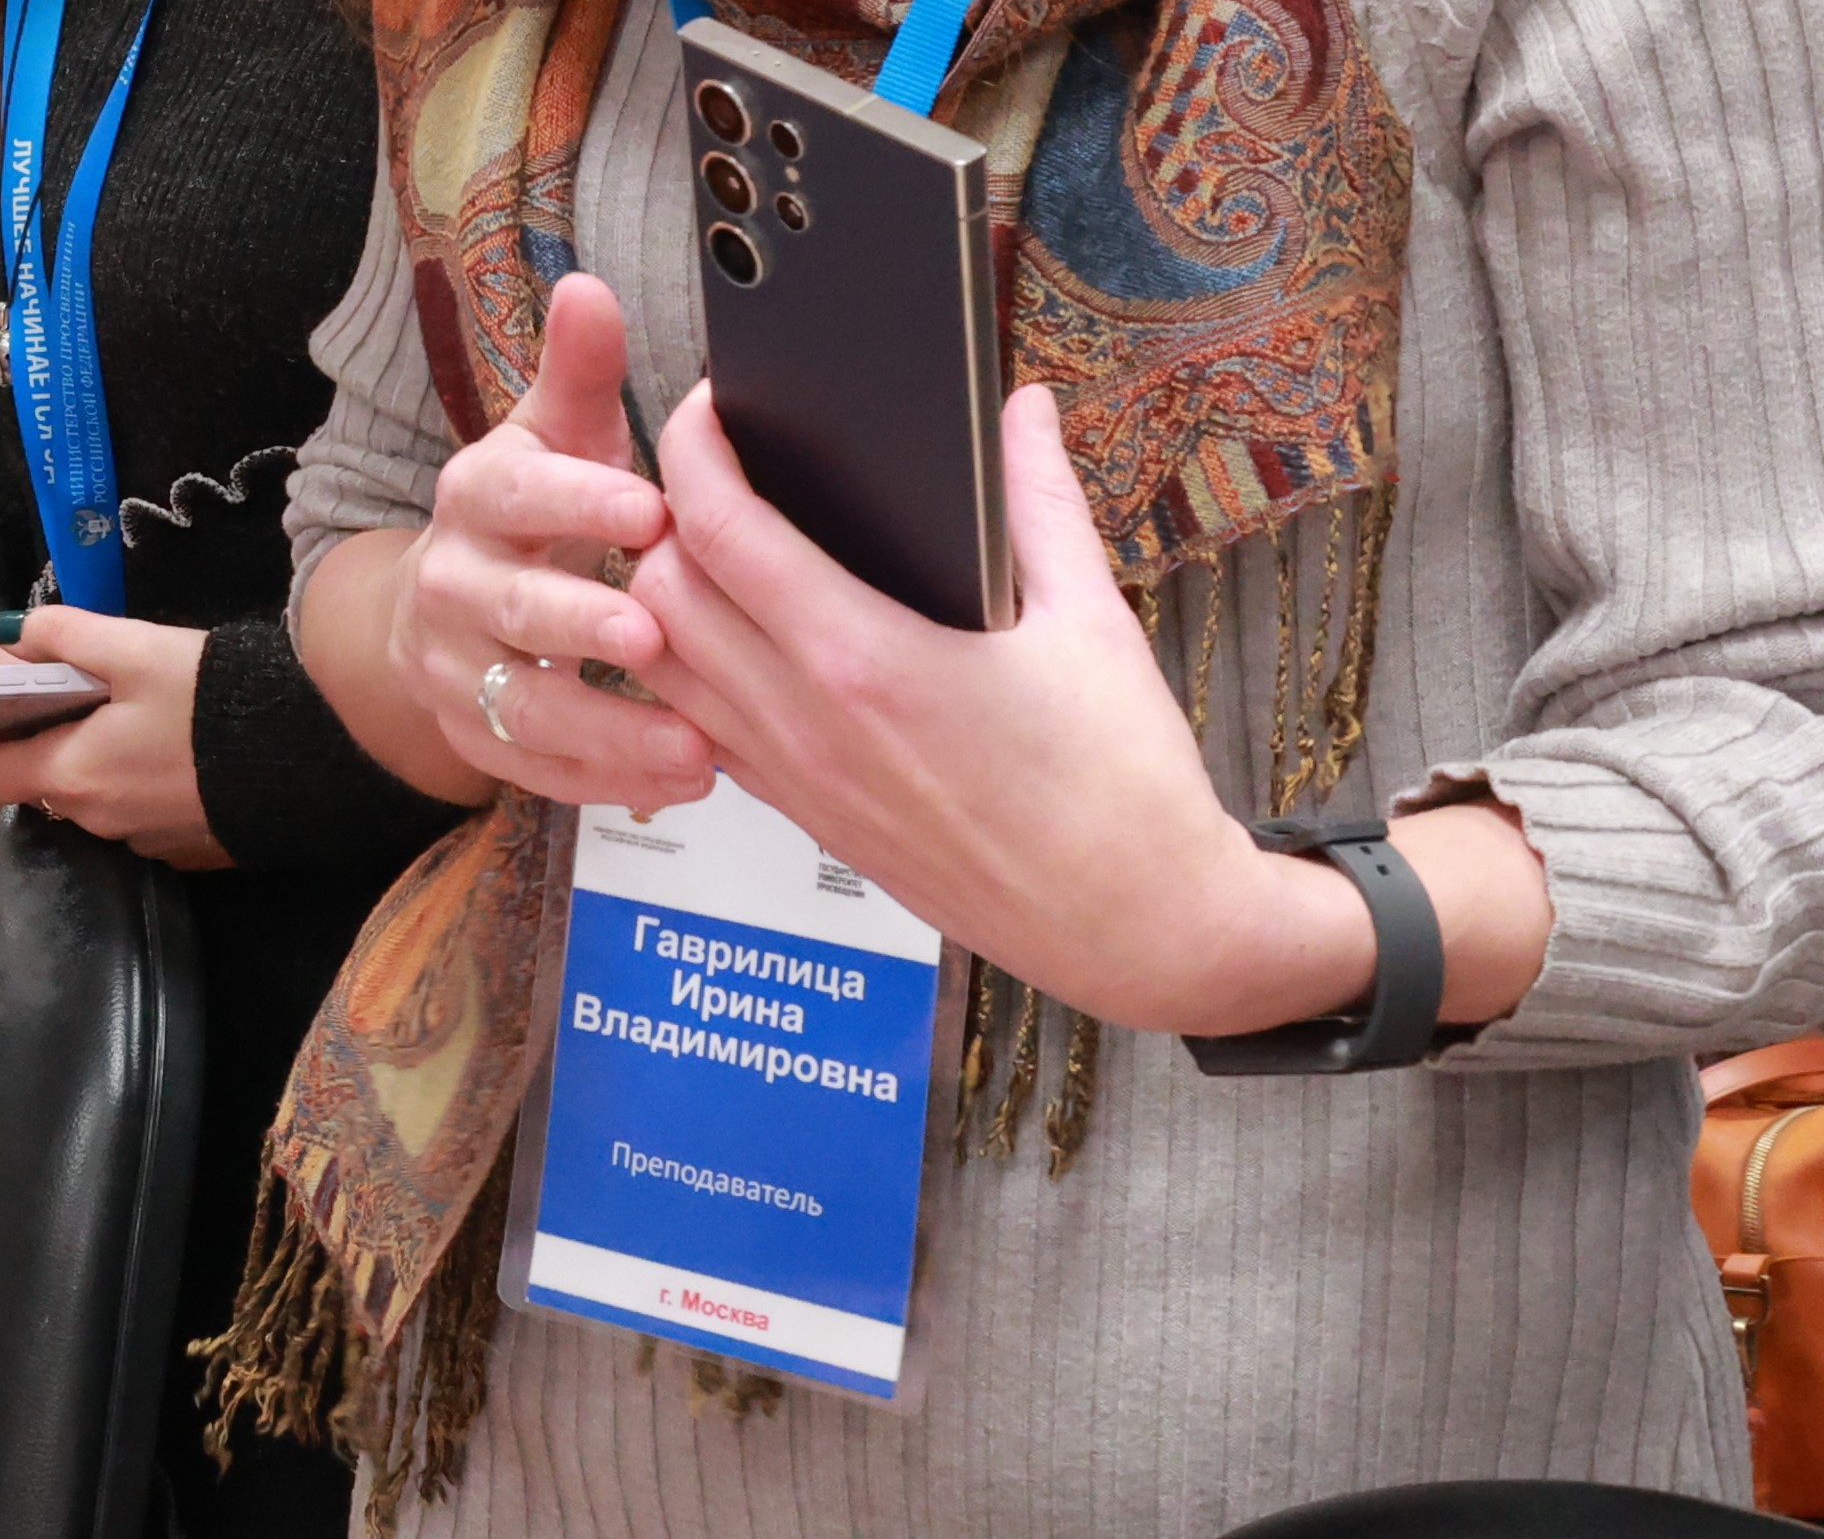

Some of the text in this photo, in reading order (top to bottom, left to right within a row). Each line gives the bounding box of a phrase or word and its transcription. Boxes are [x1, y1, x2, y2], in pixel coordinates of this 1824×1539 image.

[11, 138, 33, 254] ЛУЧШЕЕ
[59, 220, 86, 505] МИНИСТЕРСТВО ПРОСВЕЩЕНИЯ
[75, 281, 107, 503] РОССИЙСКОЙ ФЕДЕРАЦИИ
[632, 914, 867, 1002] Гаврилица
[669, 968, 806, 1035] Ирина
[571, 992, 900, 1104] Владимировна
[611, 1141, 825, 1218] Преподаватель
[659, 1287, 772, 1333] г. Москва
